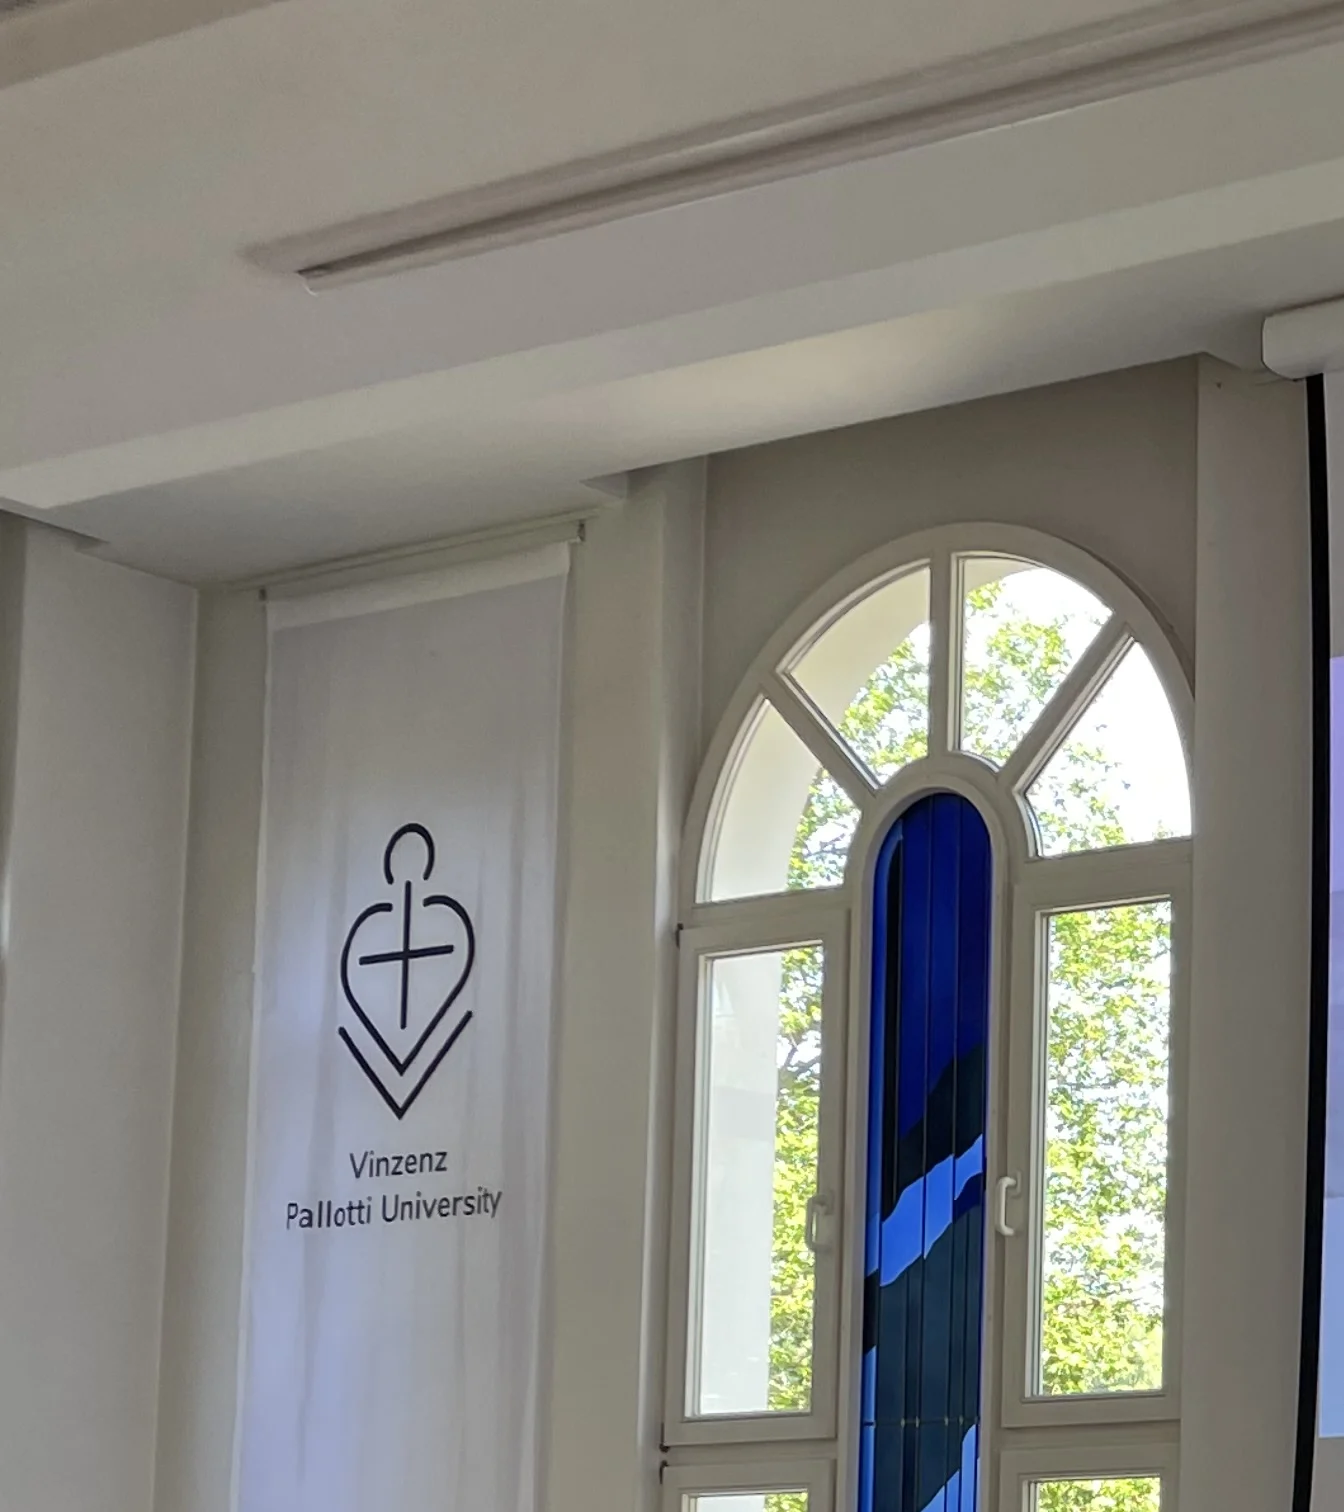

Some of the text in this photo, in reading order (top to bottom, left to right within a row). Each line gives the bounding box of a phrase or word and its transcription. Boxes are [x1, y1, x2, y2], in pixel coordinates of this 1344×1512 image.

[349, 1150, 448, 1180] Vinzenz
[286, 1187, 502, 1229] Pallotti University
